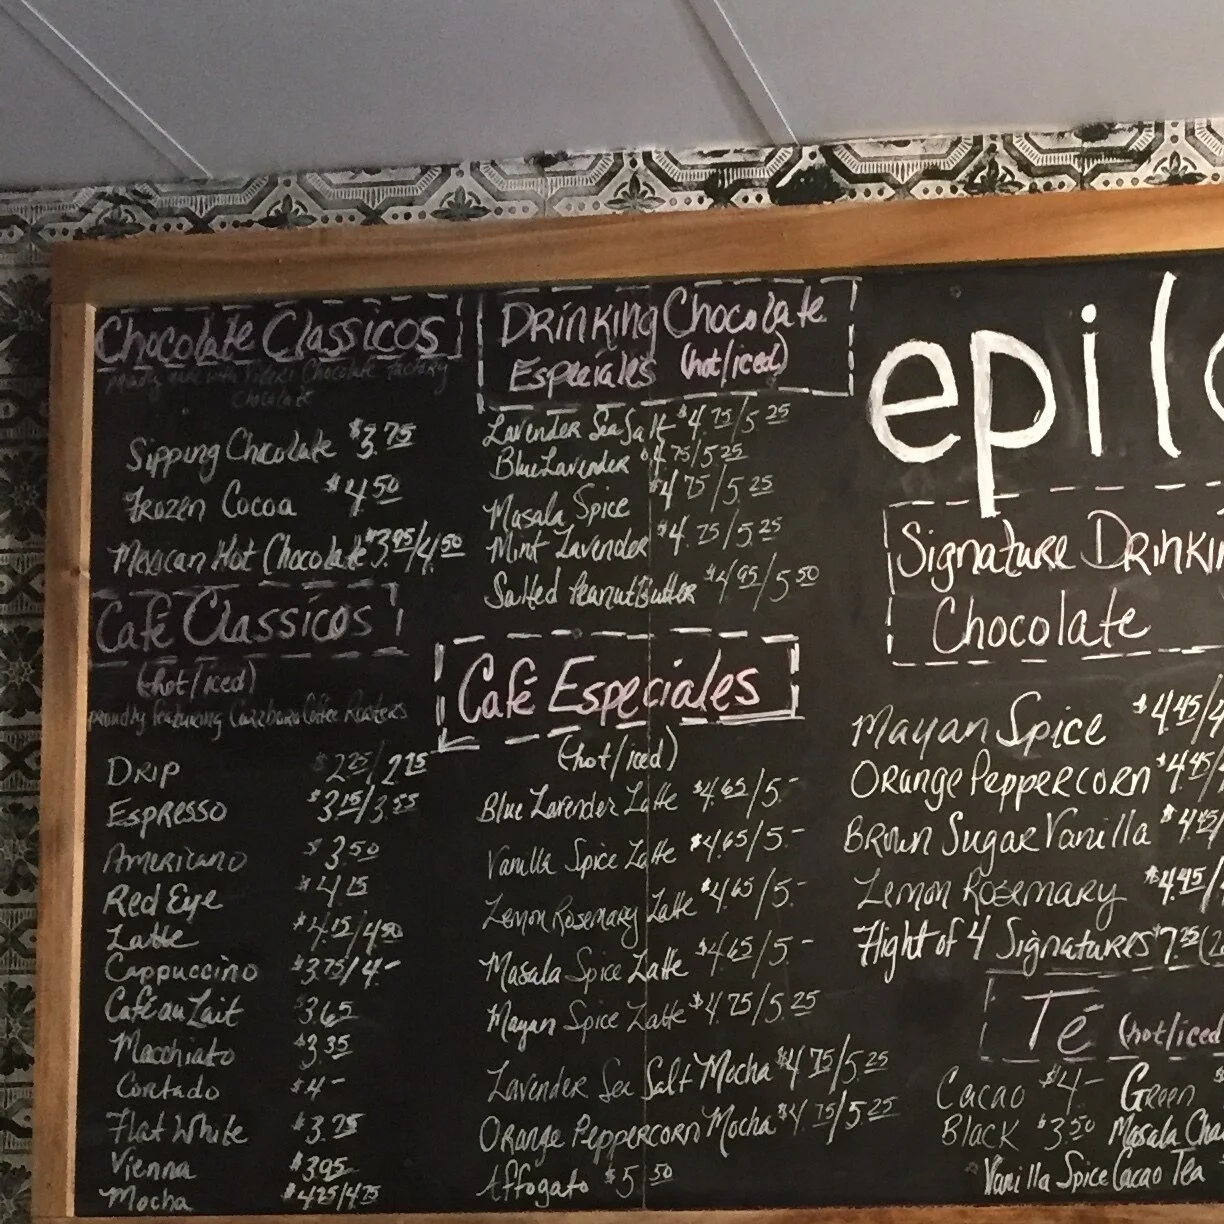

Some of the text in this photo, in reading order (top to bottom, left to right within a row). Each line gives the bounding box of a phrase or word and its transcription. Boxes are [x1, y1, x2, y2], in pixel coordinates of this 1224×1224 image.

[663, 287, 827, 338] Chocolate
[95, 309, 445, 364] Chocolate Classicos
[484, 411, 581, 444] Lavender
[127, 437, 221, 484] Sipping
[222, 479, 297, 519] Cocoa
[483, 483, 631, 531] Masala Spice
[486, 524, 649, 563] Mint Lavender
[895, 517, 1077, 593] Signature
[484, 566, 561, 610] Salted
[183, 583, 372, 645] Classicos
[931, 586, 1152, 655] Chocolate
[547, 648, 760, 728] Especiales
[852, 691, 1107, 760] Mayan Spice
[476, 780, 679, 823] Blue Lavender Latte
[850, 748, 1150, 812] Orange Peppercorn
[106, 799, 228, 839] Espresso
[941, 807, 1152, 876] Sugar Vanilla
[102, 842, 248, 874] Americano
[487, 837, 677, 880] Vanilla Spice Latte
[102, 882, 223, 924] Red Eye
[482, 887, 698, 930] Lemon Latte
[852, 867, 1128, 930] Lemon Rosemary
[106, 922, 199, 951] Latte
[104, 952, 259, 986] Cappuccino
[479, 947, 690, 994] Masala Spice Latte
[109, 1030, 236, 1067] Macchiato
[487, 999, 687, 1052] Mayan Spice Latte
[117, 1071, 219, 1100] Cortado
[487, 1049, 773, 1102] Lavender Salt Mocha
[936, 1065, 1025, 1110] Cacao
[1120, 1062, 1195, 1112] Green
[106, 1108, 165, 1144] Flat
[172, 1111, 249, 1147] White
[479, 1104, 776, 1167] Orange Peppercorn Mocha
[942, 1115, 1019, 1150] Black
[1108, 1116, 1178, 1150] Masala
[112, 1148, 197, 1181] Vienna
[477, 1159, 590, 1208] Affogato
[984, 1147, 1162, 1196] Vanilla Spice Cacao
[99, 1185, 194, 1212] Mocha
